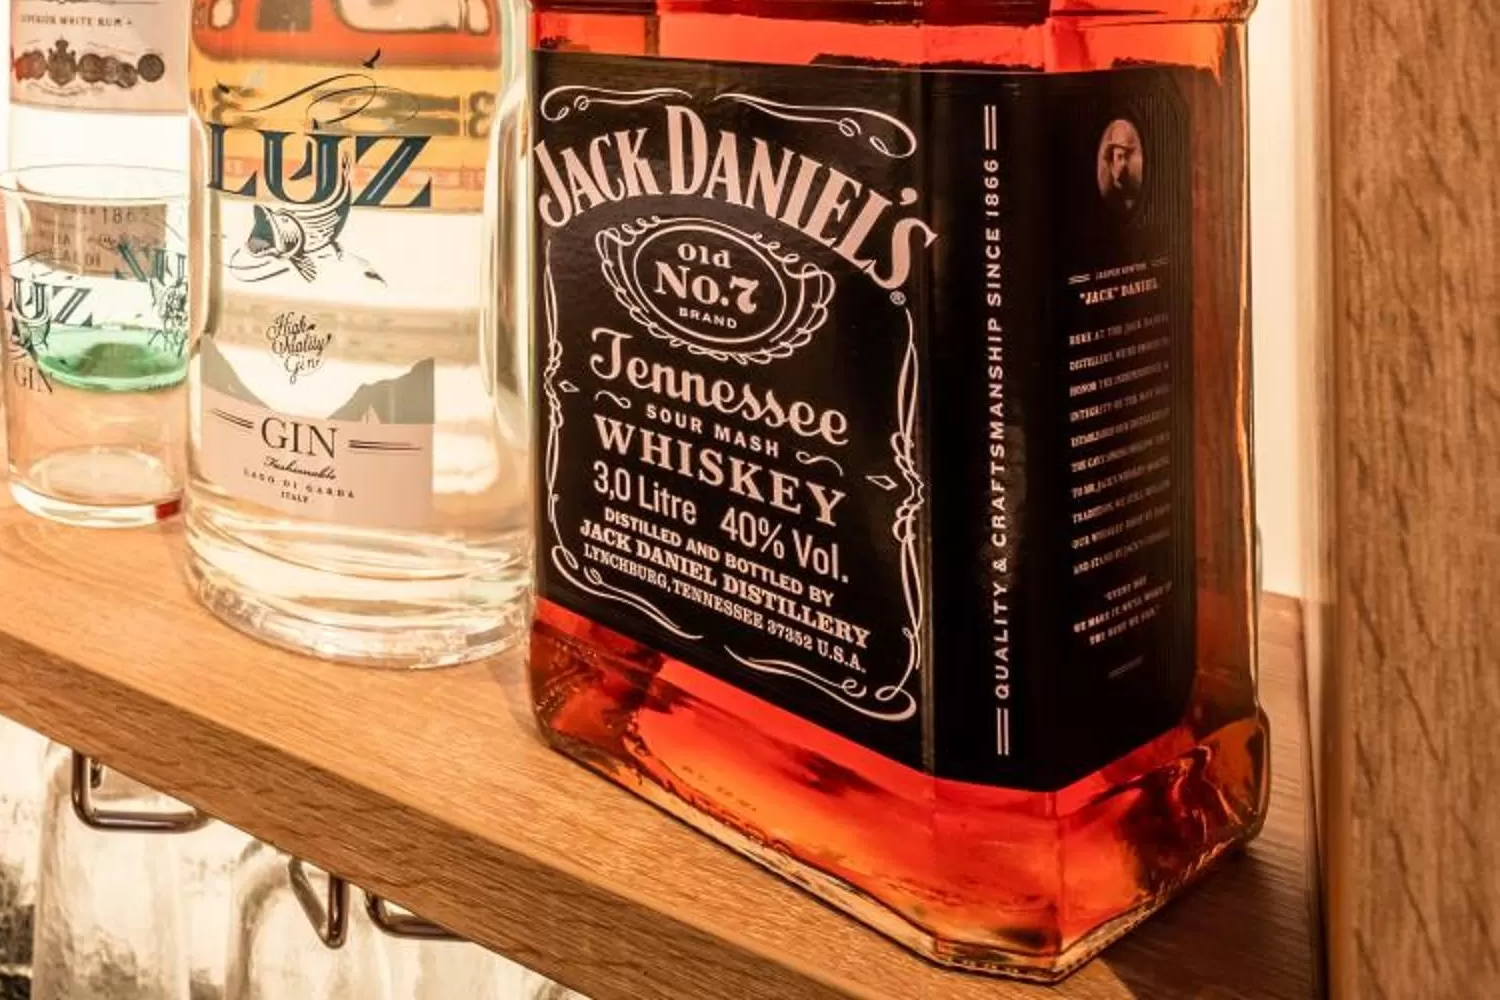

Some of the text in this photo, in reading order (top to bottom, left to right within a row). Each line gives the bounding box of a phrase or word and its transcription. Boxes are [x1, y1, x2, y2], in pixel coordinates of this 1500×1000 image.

[97, 17, 122, 28] RUM
[207, 122, 432, 208] LUZ
[677, 243, 731, 269] Old
[8, 275, 94, 328] UZ
[654, 260, 759, 314] No.7
[1121, 277, 1158, 296] DANIEL
[679, 306, 737, 329] BRAND
[590, 328, 849, 446] Tennessee
[261, 416, 339, 459] GIN
[646, 404, 780, 458] SOUR MASH
[984, 159, 1010, 700] QUALITY & CRAFTSMANSHIP SINCE 1866
[593, 413, 847, 527] WHISKEY
[281, 491, 310, 505] ITALY
[593, 460, 849, 584] 3,0 Litre 40% Vol.
[580, 519, 871, 649] JACK DANIEL DISTILLERY
[604, 507, 835, 608] DISTILLED AND BOTTLED BY
[583, 543, 867, 673] LYNCHBURG, TENNESSEE 37352 U.S.A.
